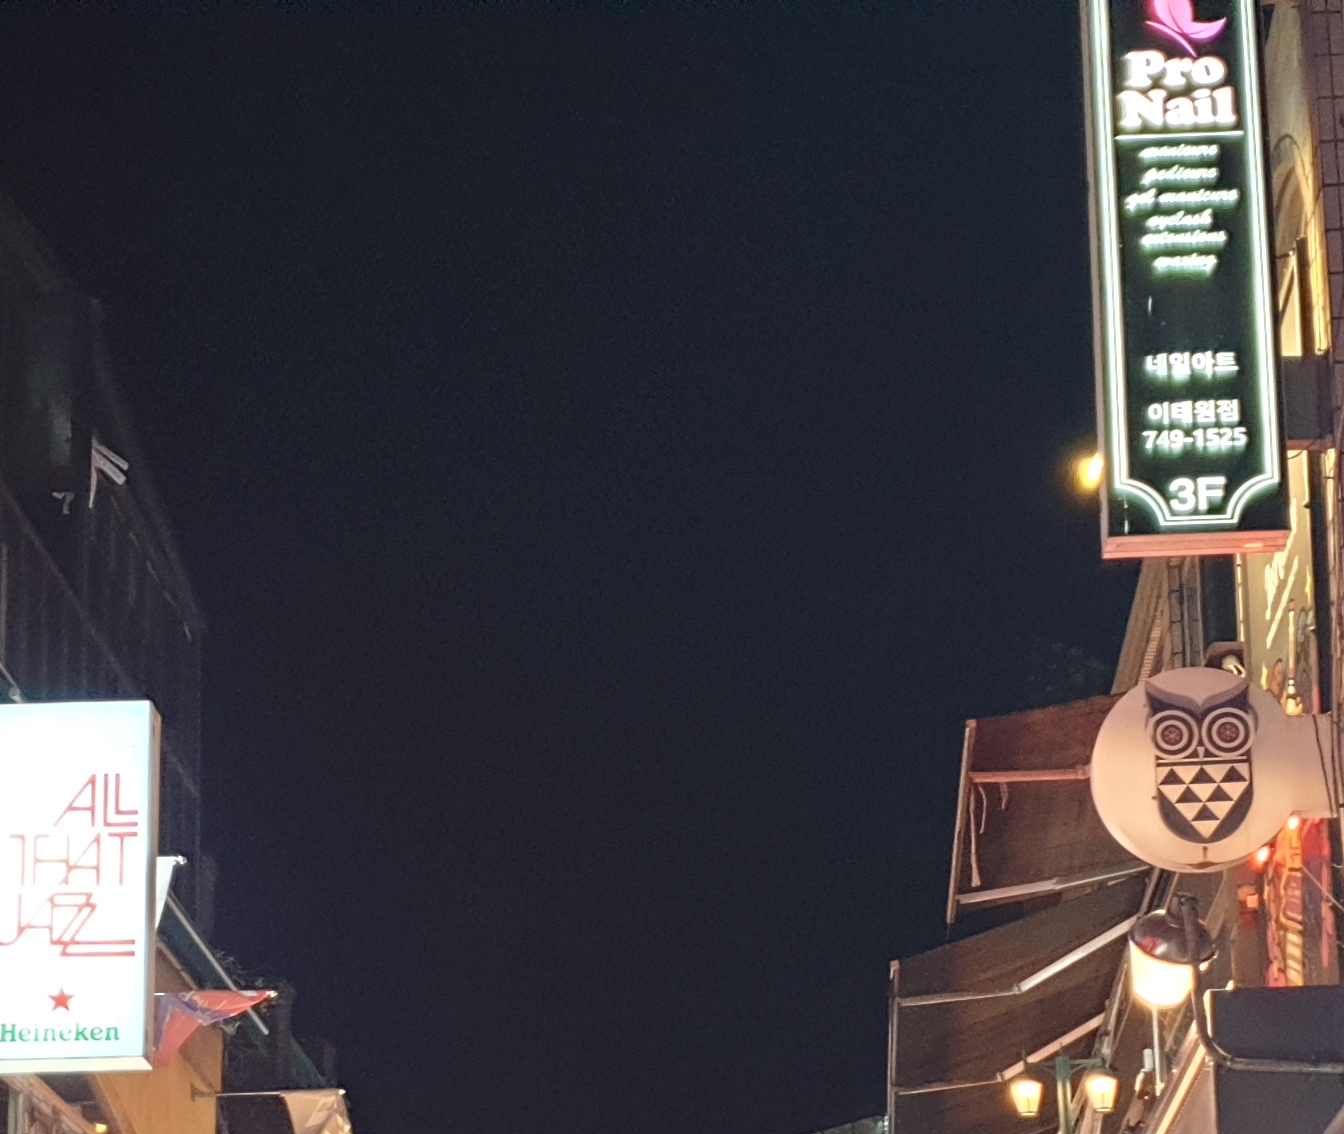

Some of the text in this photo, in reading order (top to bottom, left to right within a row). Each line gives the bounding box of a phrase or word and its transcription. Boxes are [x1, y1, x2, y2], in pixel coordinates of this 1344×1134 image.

[1122, 50, 1226, 88] Pro
[1117, 87, 1236, 132] Nail
[1144, 351, 1239, 381] 네일아트
[1148, 399, 1239, 426] 이태원점
[1143, 427, 1248, 450] 749-1525
[1169, 476, 1227, 512] 3F
[53, 773, 138, 827] ALL
[8, 832, 138, 886] THAT
[0, 1023, 120, 1043] Heineken
